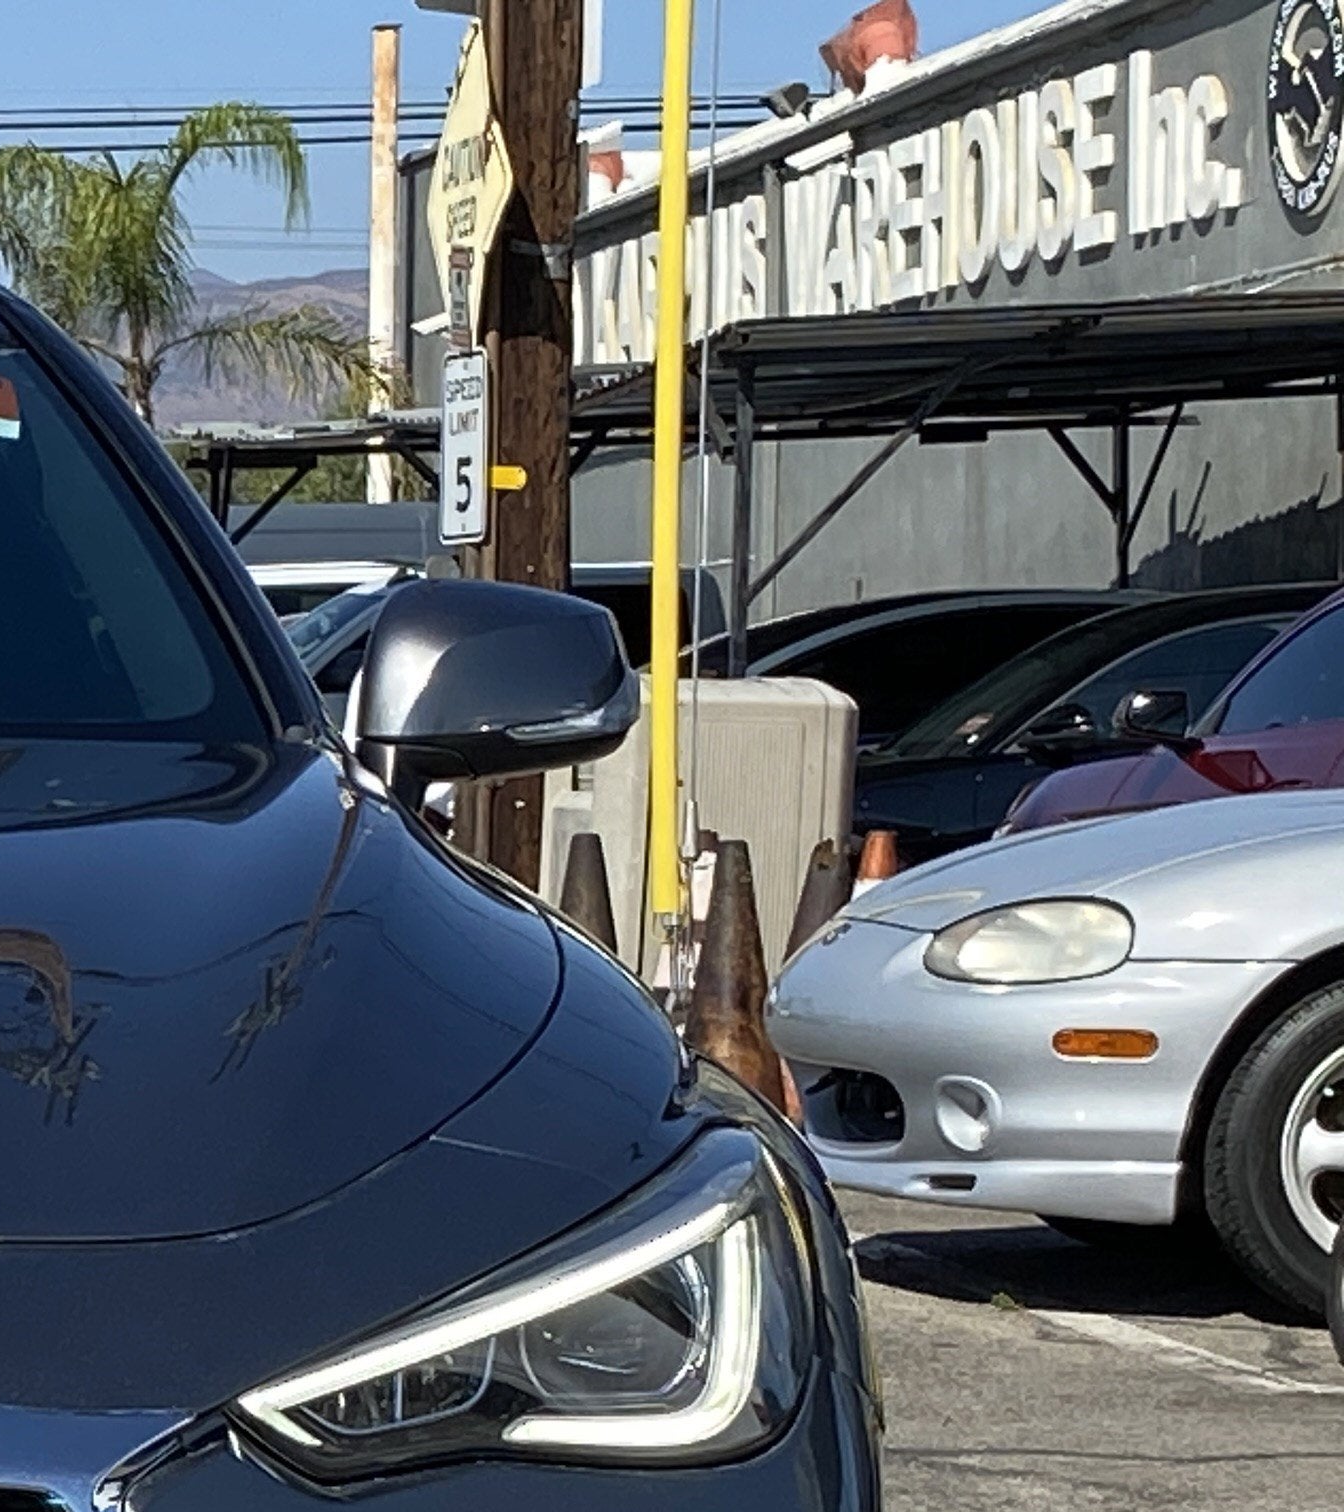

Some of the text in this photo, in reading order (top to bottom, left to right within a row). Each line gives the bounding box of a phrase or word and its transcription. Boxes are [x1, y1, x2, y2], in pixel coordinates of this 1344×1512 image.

[783, 63, 1117, 317] WAREHOUSE
[1127, 49, 1242, 236] Inc.
[446, 375, 482, 404] SPEED
[448, 408, 480, 437] LIMIT
[455, 456, 473, 513] 5
